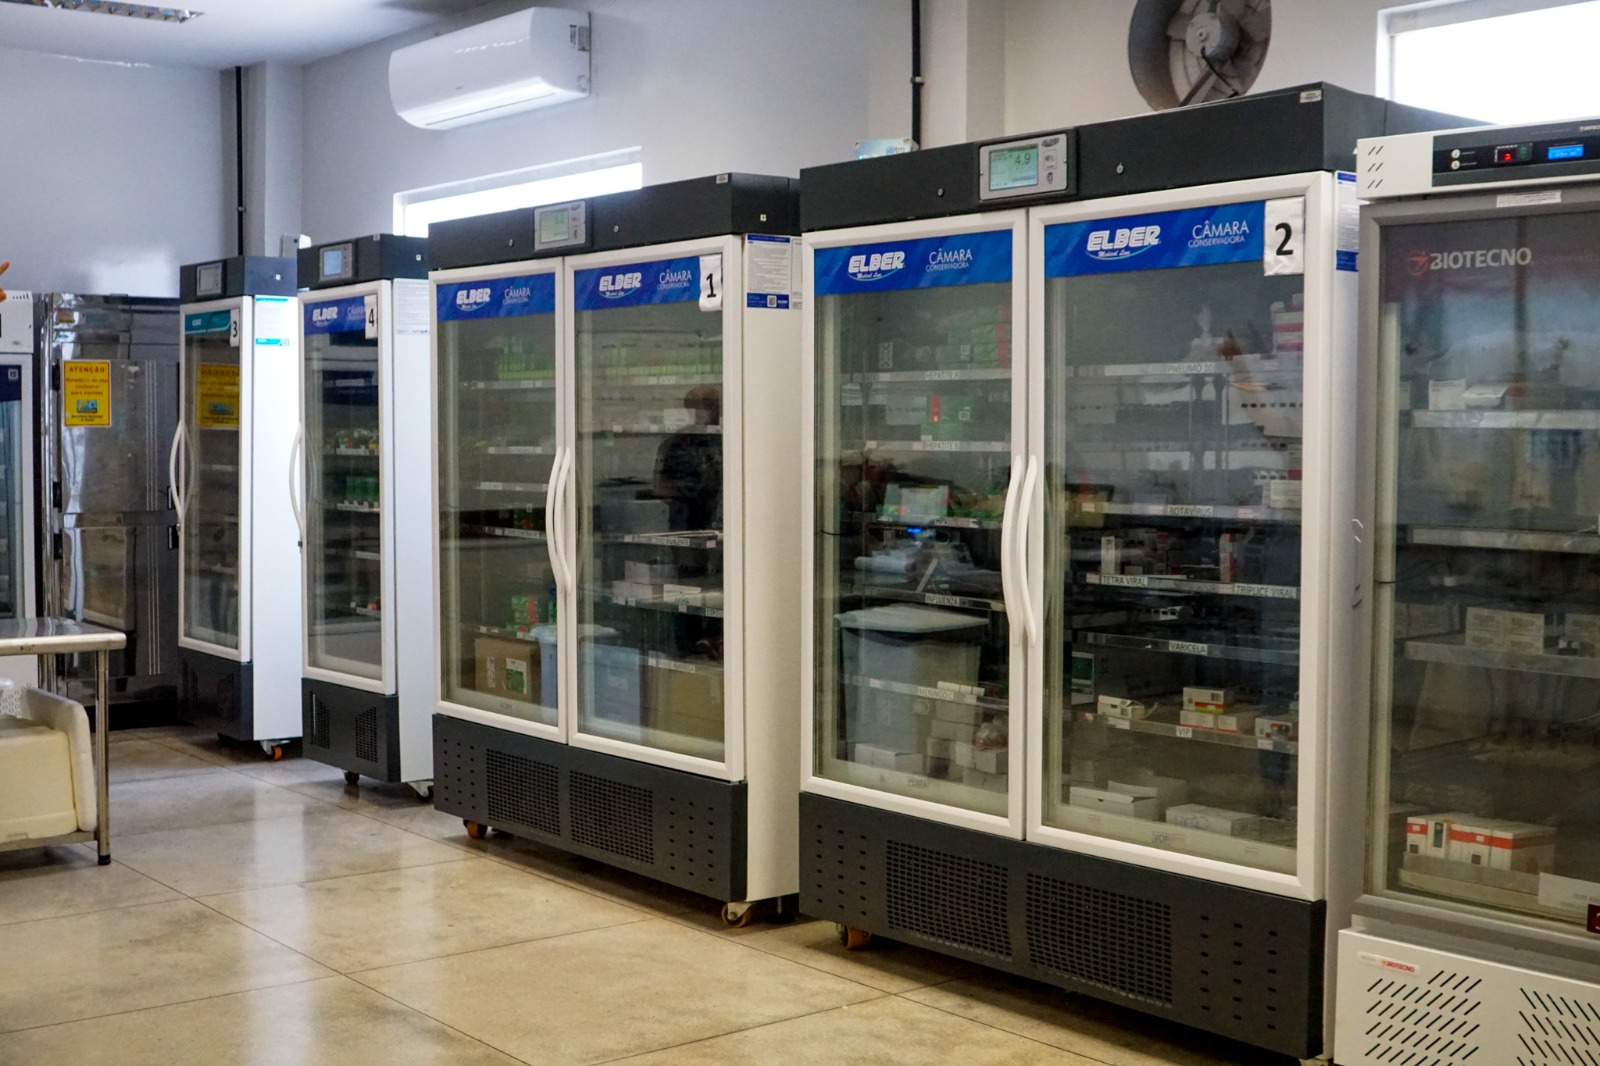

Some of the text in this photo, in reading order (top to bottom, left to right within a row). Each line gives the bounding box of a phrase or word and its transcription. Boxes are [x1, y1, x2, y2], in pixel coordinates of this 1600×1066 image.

[1014, 152, 1031, 166] 4.9
[1192, 220, 1250, 239] CÂMARA
[1086, 225, 1161, 252] ELBER
[1188, 235, 1245, 248] CONSERVADORA
[1274, 222, 1294, 256] 2
[848, 251, 905, 274] ELBER
[929, 248, 973, 265] CÂMARA
[1430, 247, 1533, 270] BIOTECNO
[926, 262, 969, 273] CONSERVADORA
[598, 272, 642, 292] ELBER
[659, 269, 692, 284] CÂMARA
[705, 273, 717, 298] 1
[456, 288, 491, 305] ELBER
[504, 286, 531, 299] CÂMARA
[368, 308, 375, 328] 4
[232, 320, 238, 338] 3
[69, 365, 105, 374] ATENÇÃO
[925, 370, 953, 379] HEPATITE
[926, 441, 953, 450] HEPATITE
[1168, 506, 1212, 517] ROTAVIRUS
[1102, 575, 1147, 587] TETRA VIRAL
[1270, 586, 1295, 598] VIRAL
[925, 594, 959, 606] INFLUENZA
[1170, 642, 1207, 654] VARICELA
[918, 687, 948, 699] MENINGO
[1178, 727, 1191, 737] VIP
